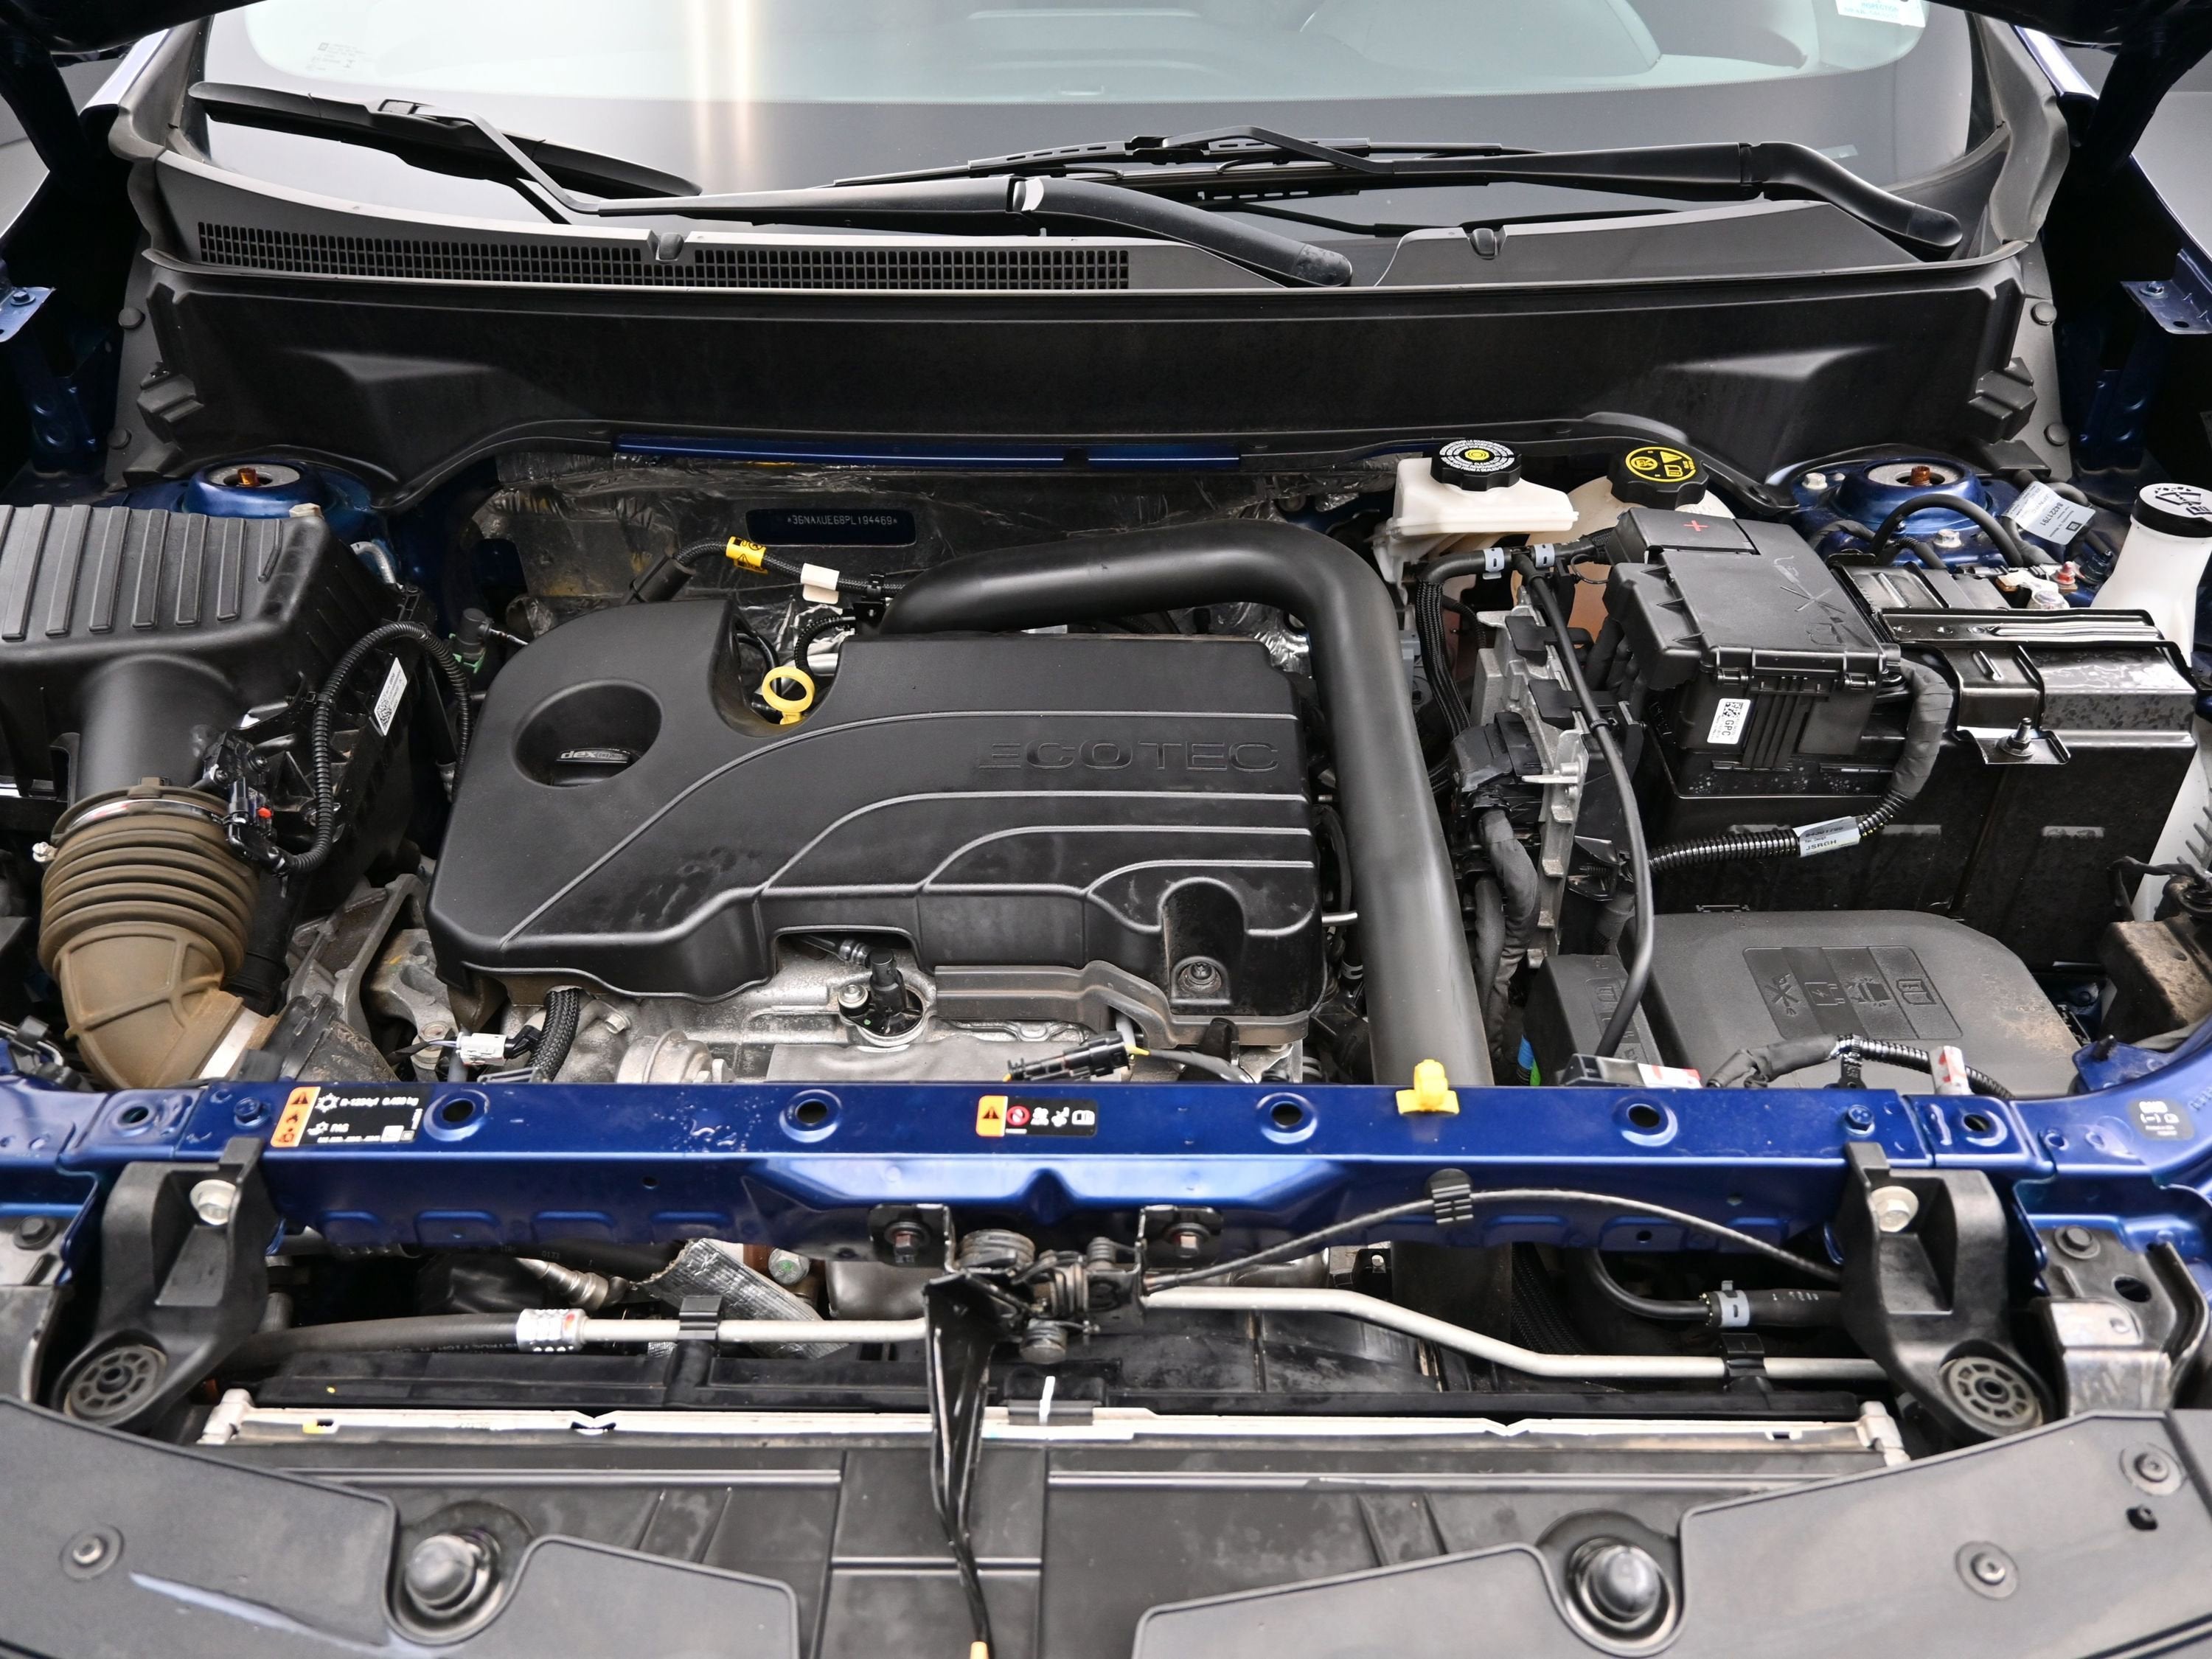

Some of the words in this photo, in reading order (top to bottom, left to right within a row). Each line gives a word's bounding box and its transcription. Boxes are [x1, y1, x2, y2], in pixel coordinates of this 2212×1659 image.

[1722, 720, 1734, 736] GPC
[560, 750, 623, 760] dexos
[978, 740, 1280, 773] ECOTEC
